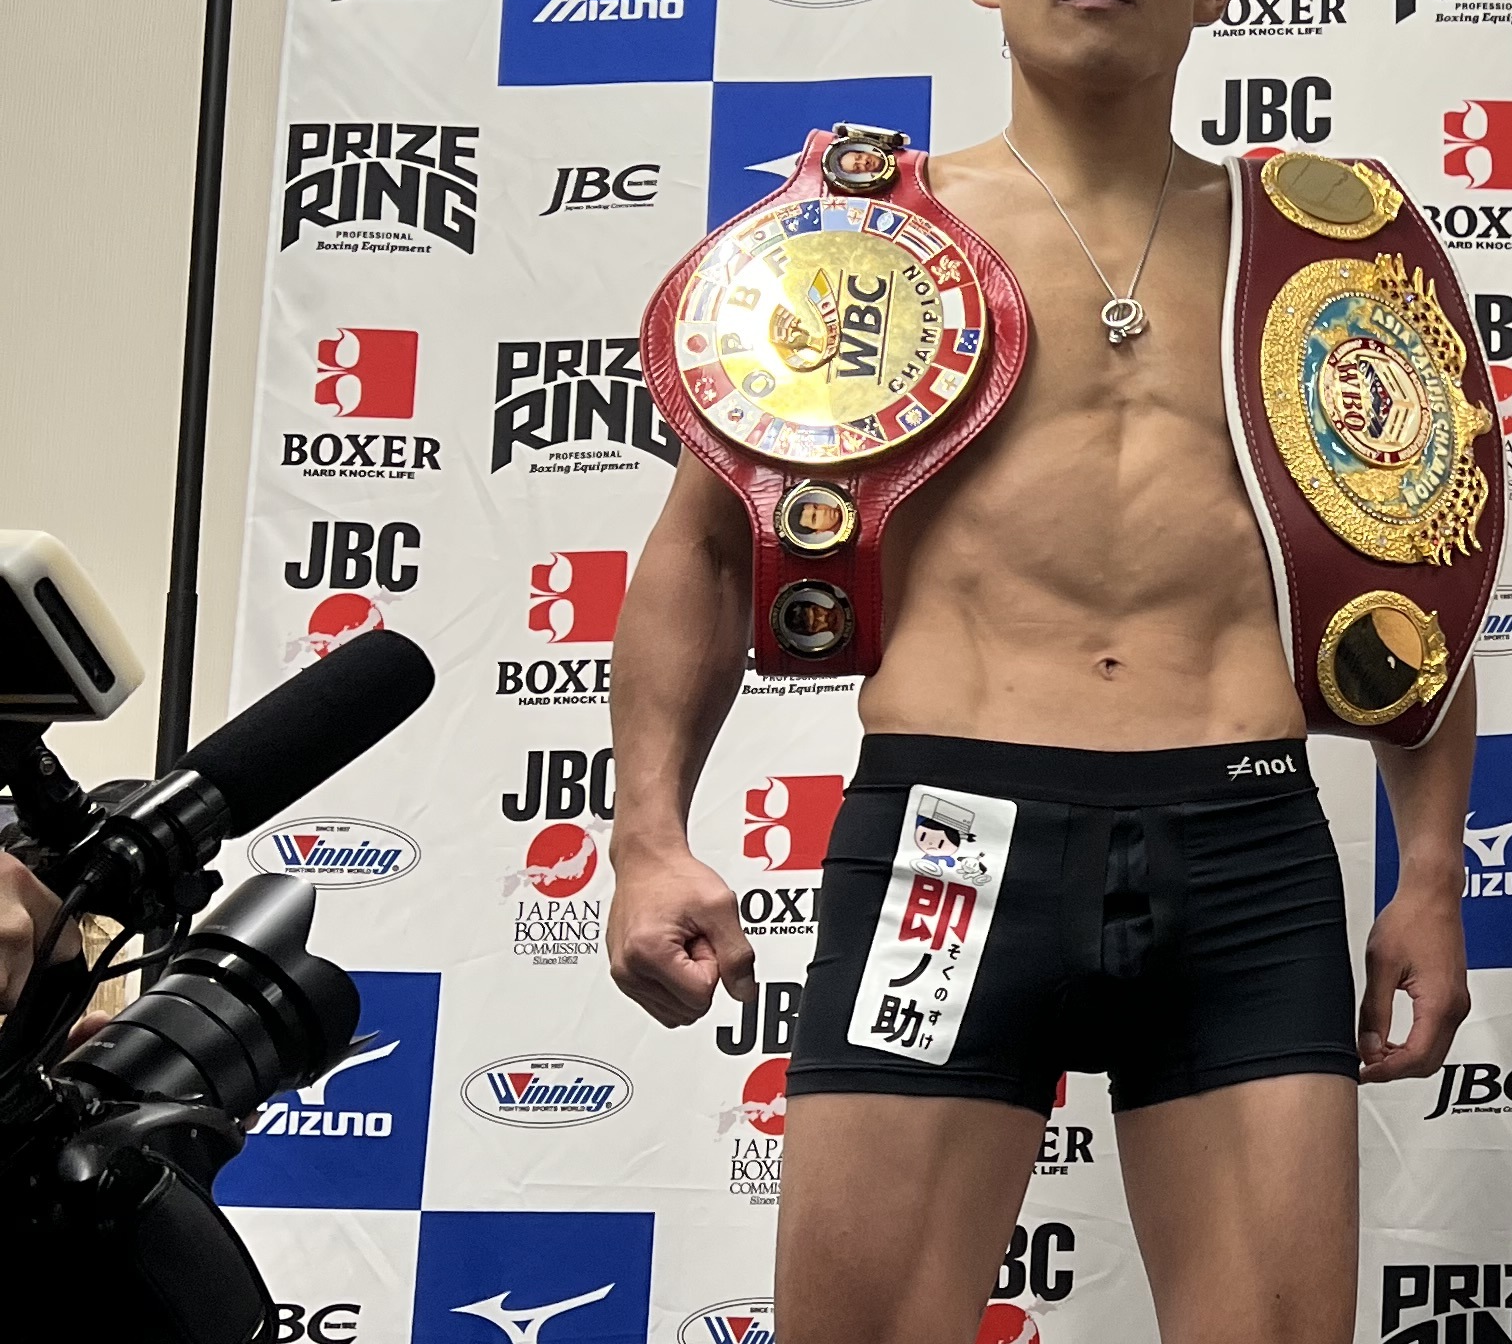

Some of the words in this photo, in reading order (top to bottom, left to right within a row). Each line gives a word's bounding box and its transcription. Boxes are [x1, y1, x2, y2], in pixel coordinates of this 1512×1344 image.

[1213, 28, 1246, 38] HARD
[1249, 27, 1294, 37] KNOCK
[1297, 26, 1323, 36] LIFE
[1436, 13, 1479, 24] Boxing
[1201, 76, 1332, 146] JBC
[286, 123, 479, 187] PRIZE
[280, 162, 477, 254] RING
[539, 164, 660, 216] JBC
[837, 274, 888, 378] WBC
[888, 263, 941, 396] CHAMPION
[495, 338, 643, 404] PRIZ
[1337, 363, 1366, 432] WBO
[281, 434, 441, 470] BOXER
[491, 379, 682, 475] RING
[283, 521, 422, 591] JBC
[272, 836, 400, 873] Winning
[514, 921, 600, 942] BOXING
[515, 900, 600, 921] JAPAN
[513, 942, 599, 956] COMMISSION
[871, 874, 977, 1048] 即ノ助
[919, 944, 961, 1049] そくのすけ
[487, 1074, 613, 1110] Winning
[989, 1222, 1075, 1302] BC
